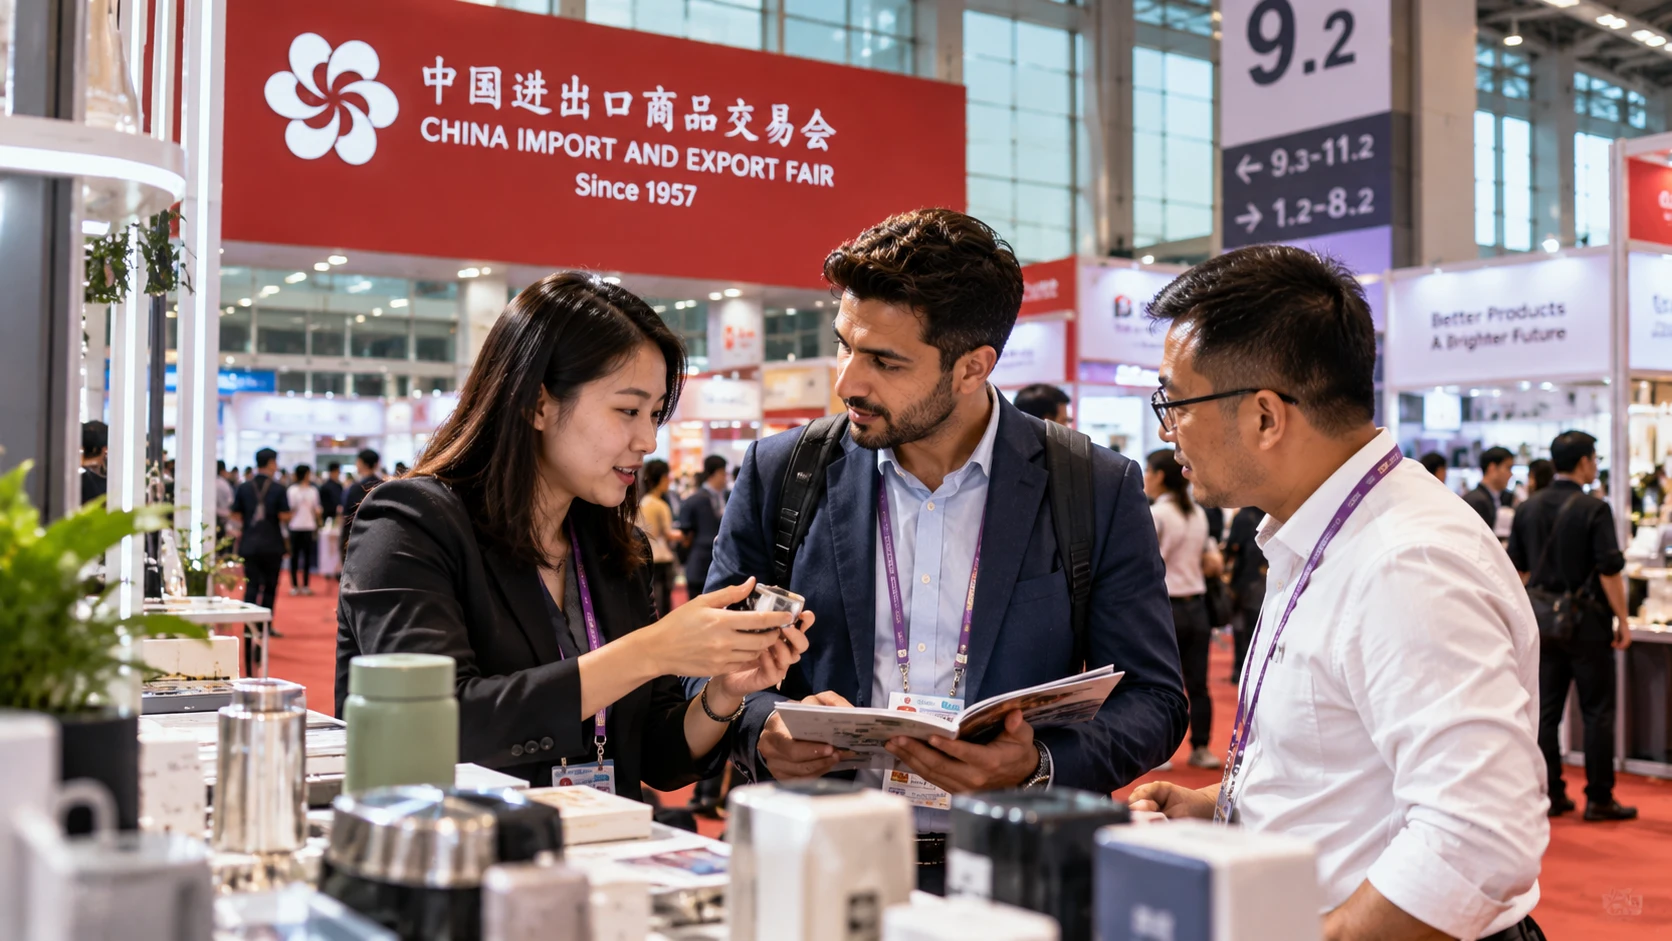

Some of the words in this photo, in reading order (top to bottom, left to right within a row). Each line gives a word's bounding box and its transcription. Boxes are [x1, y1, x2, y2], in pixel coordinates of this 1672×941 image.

[1246, 0, 1356, 86] 9.2
[421, 55, 838, 152] 中国进出口商品交易会
[420, 116, 509, 150] CHINA
[517, 127, 618, 161] IMPORT
[624, 140, 679, 168] AND
[686, 147, 779, 180] EXPORT
[786, 159, 835, 188] FAIR
[1270, 134, 1375, 178] 9.3-11.2
[574, 172, 640, 201] Since
[645, 180, 698, 207] 1957
[1272, 187, 1375, 228] 1.2-8.2
[1431, 311, 1481, 328] Better
[1487, 303, 1566, 322] Products
[1431, 335, 1442, 350] A
[1446, 333, 1508, 351] Brighter
[1512, 327, 1567, 344] Future
